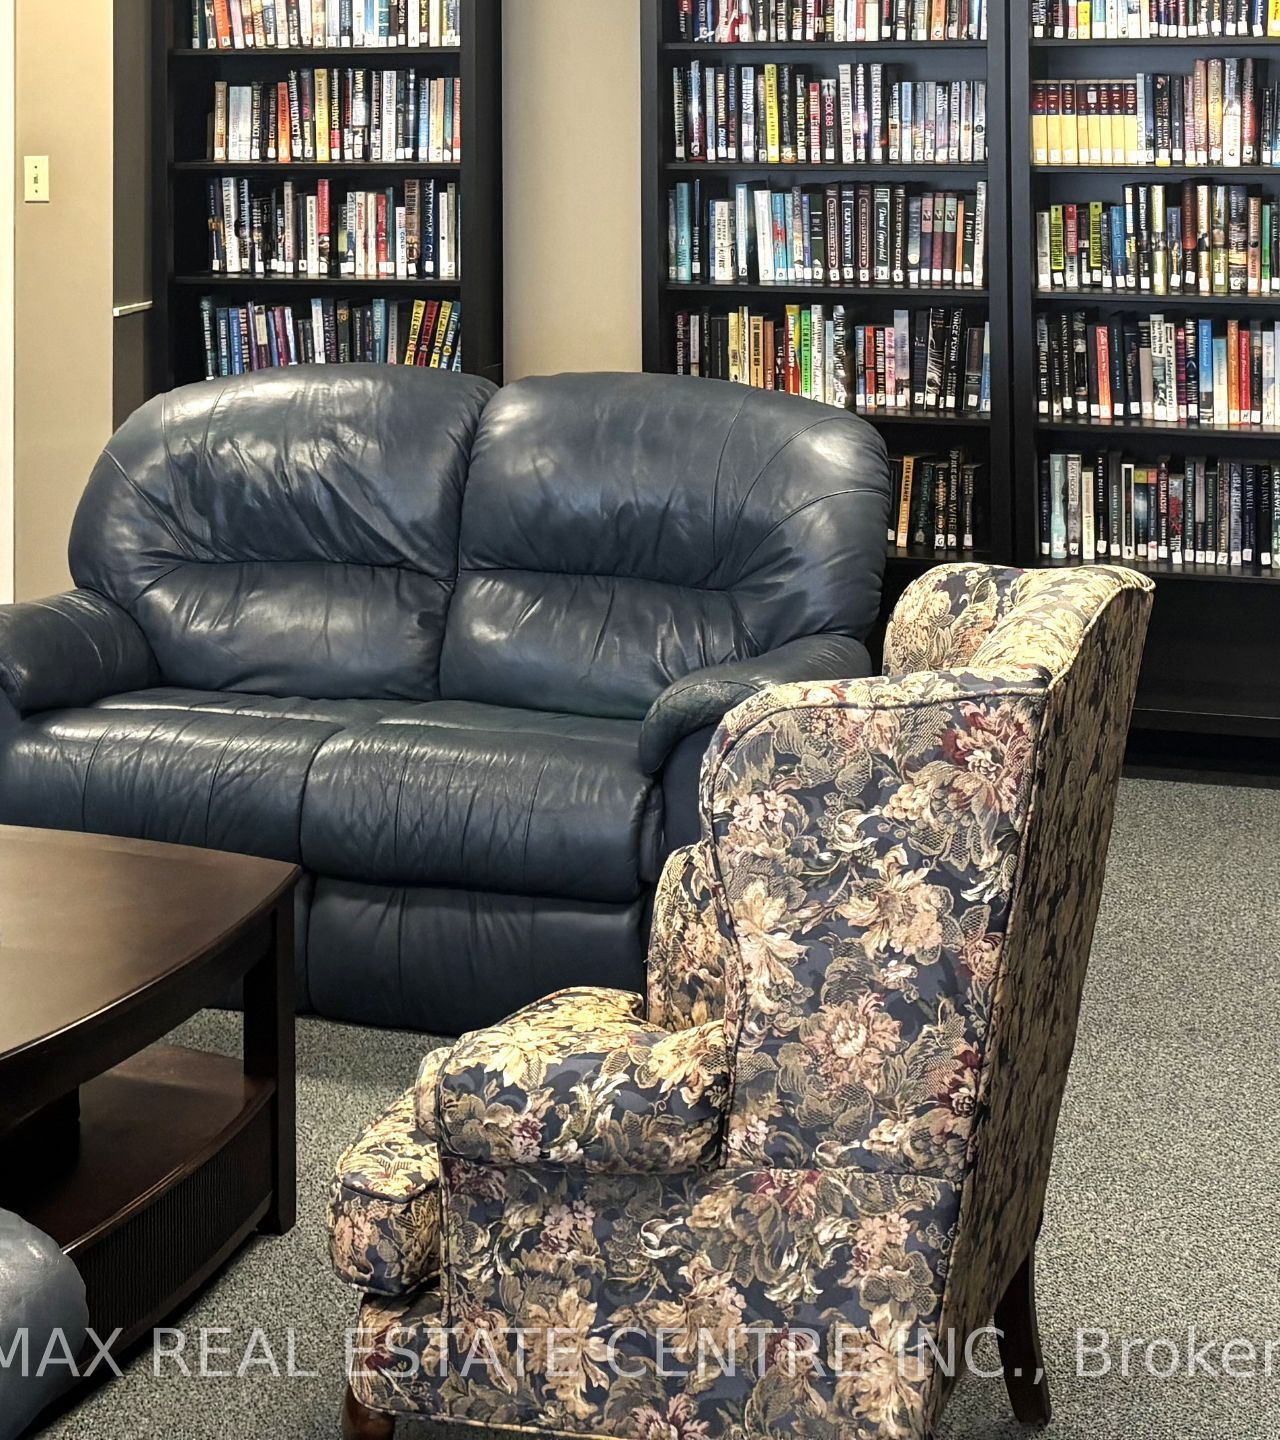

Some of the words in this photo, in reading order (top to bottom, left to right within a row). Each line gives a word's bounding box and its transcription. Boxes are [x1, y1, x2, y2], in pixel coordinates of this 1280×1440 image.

[825, 15, 835, 33] WIN
[354, 71, 366, 92] DAVID
[871, 65, 882, 87] CLIVE
[253, 90, 261, 108] DAVID
[289, 80, 297, 100] DAVID
[742, 79, 755, 115] AUTOPSY
[871, 87, 882, 118] CUSSLER
[331, 99, 340, 129] BALDACCI
[717, 98, 726, 126] CORNWELL
[796, 96, 806, 130] ROBERT
[825, 95, 834, 115] BOX
[842, 86, 852, 127] AMERICAN
[253, 108, 261, 137] BALDACCI
[290, 100, 301, 137] BALDACCI
[843, 128, 853, 146] DIRT
[223, 180, 231, 204] STEVE
[240, 180, 248, 202] STEVE
[224, 204, 233, 230] BERRY
[240, 202, 249, 226] BERRY
[406, 194, 418, 216] BROWN
[1139, 203, 1147, 230] GRISHAM
[844, 207, 853, 234] OLIVER
[844, 234, 853, 260] TWIST
[1052, 237, 1062, 268] GRISHAM
[1091, 236, 1101, 265] GRISHAM
[202, 310, 211, 330] SANDRA
[219, 319, 228, 338] SANDRA
[788, 315, 796, 339] JAMES
[951, 311, 961, 335] VINCE
[204, 330, 213, 350] BROWN
[409, 323, 420, 343] CHILD
[220, 338, 229, 356] BROWN
[788, 339, 796, 368] ELLROY
[950, 336, 959, 362] FLYNN
[1163, 360, 1174, 390] sleeping
[1246, 485, 1256, 510] JEWELL
[1260, 487, 1269, 513] JEWELL
